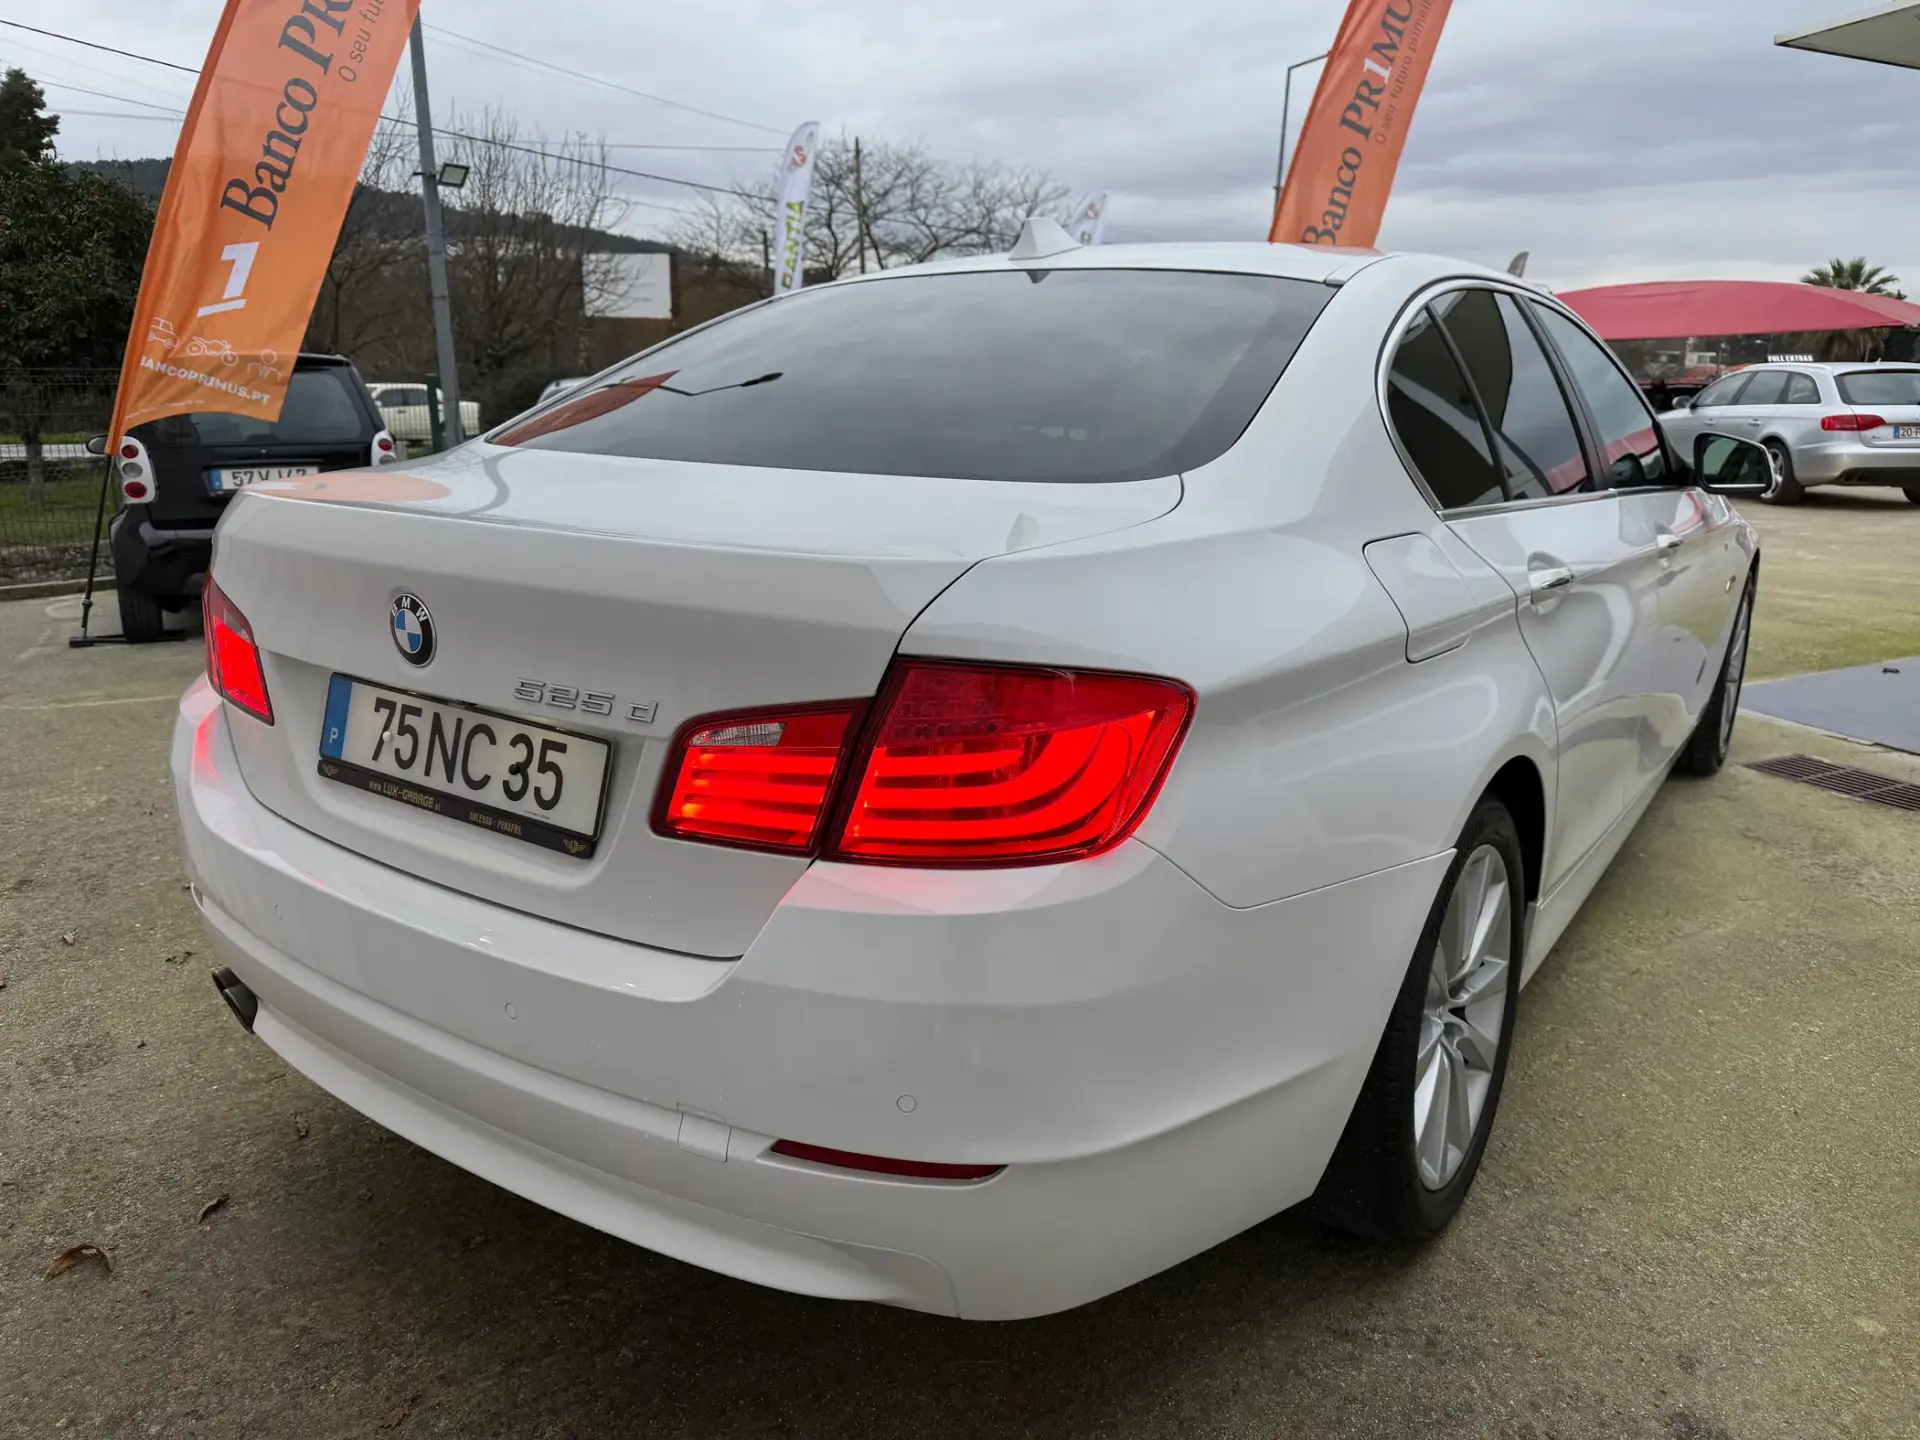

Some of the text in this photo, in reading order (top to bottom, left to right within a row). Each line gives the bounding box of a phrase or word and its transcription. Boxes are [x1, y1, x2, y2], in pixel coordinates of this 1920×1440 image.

[338, 65, 357, 82] O
[349, 28, 372, 63] seu
[1381, 103, 1396, 131] seu
[1391, 54, 1412, 101] futuro
[220, 77, 318, 231] Banco
[1302, 146, 1362, 245] Banco
[391, 596, 428, 622] BMW
[513, 677, 659, 724] 525 d
[328, 727, 339, 744] P
[371, 697, 568, 811] 75NC35
